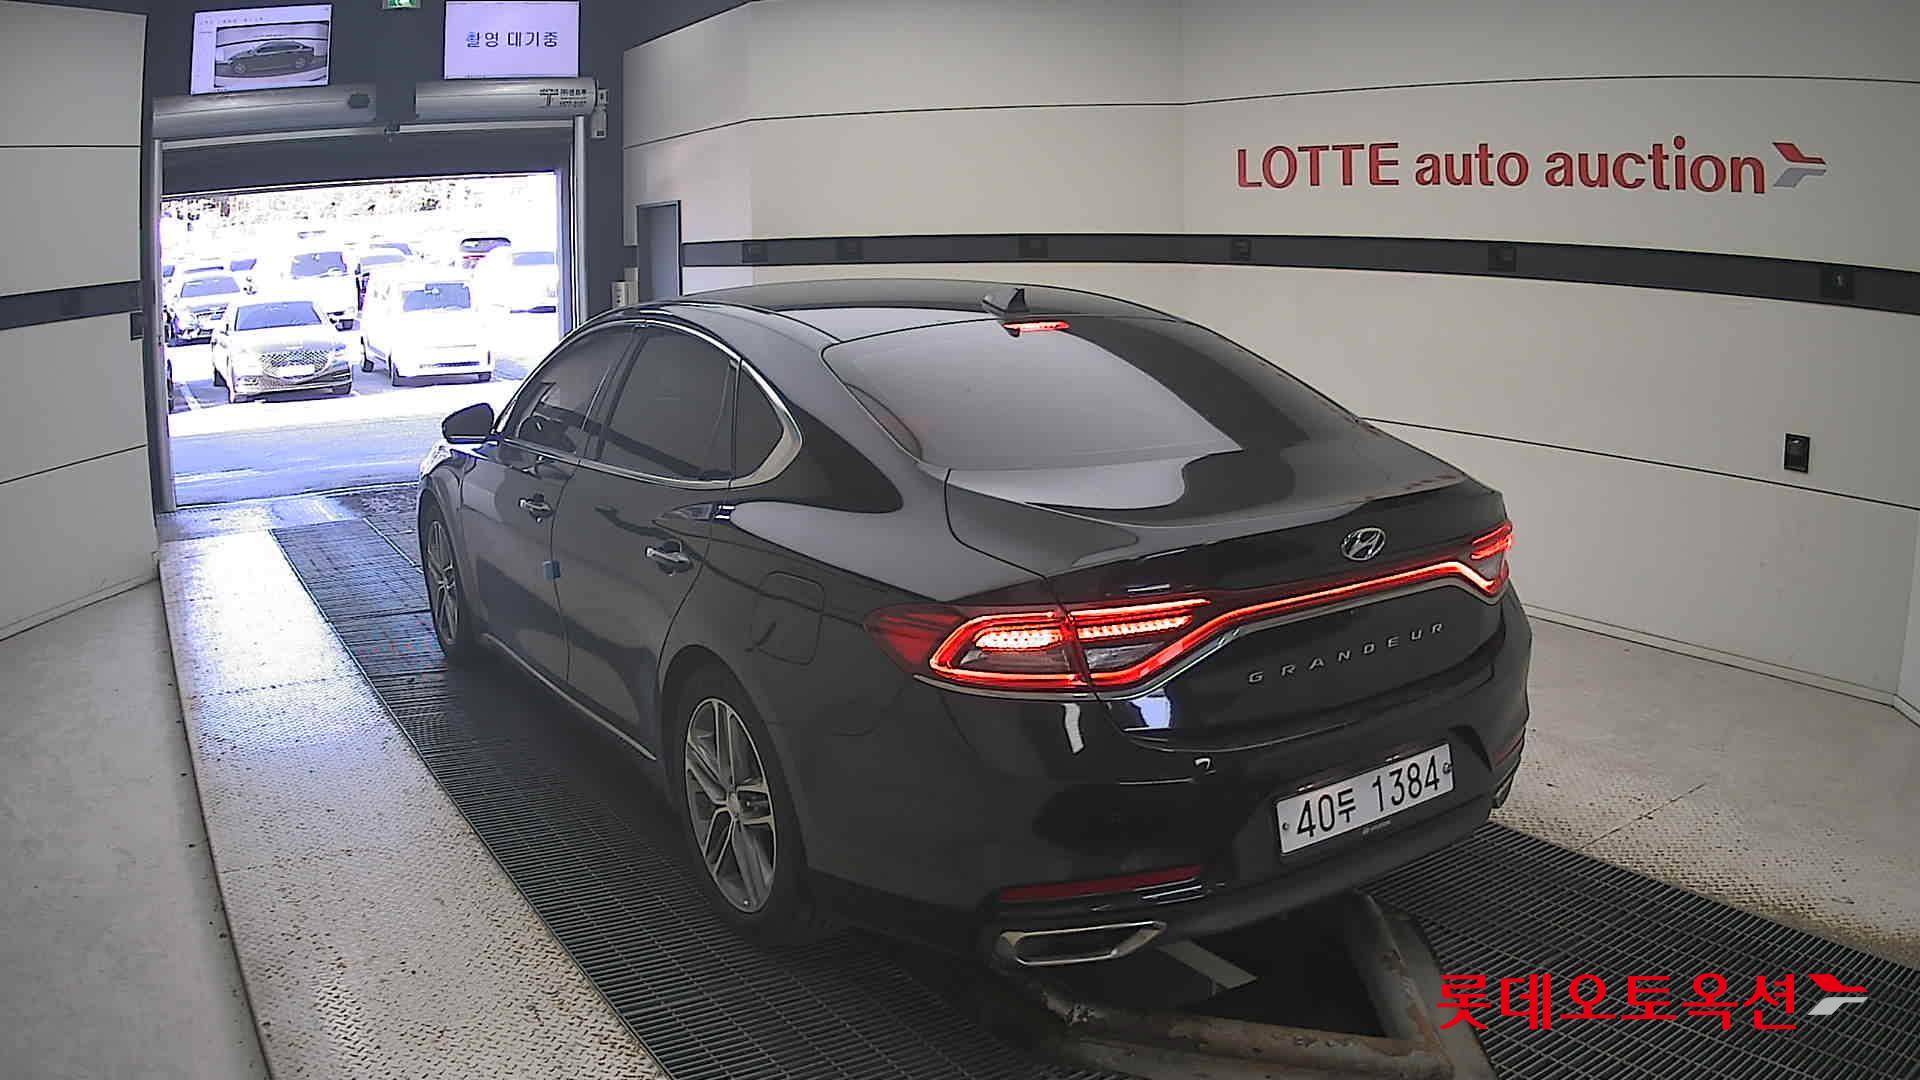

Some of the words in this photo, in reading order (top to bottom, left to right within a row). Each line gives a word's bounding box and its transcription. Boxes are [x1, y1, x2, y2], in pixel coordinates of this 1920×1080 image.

[507, 31, 559, 48] 대기중
[1237, 141, 1400, 188] LOTTE
[1414, 143, 1530, 187] auto
[1543, 135, 1766, 194] auction
[1248, 622, 1443, 684] GRANDEUR
[1297, 788, 1356, 838] 40두
[1372, 755, 1440, 813] 1384
